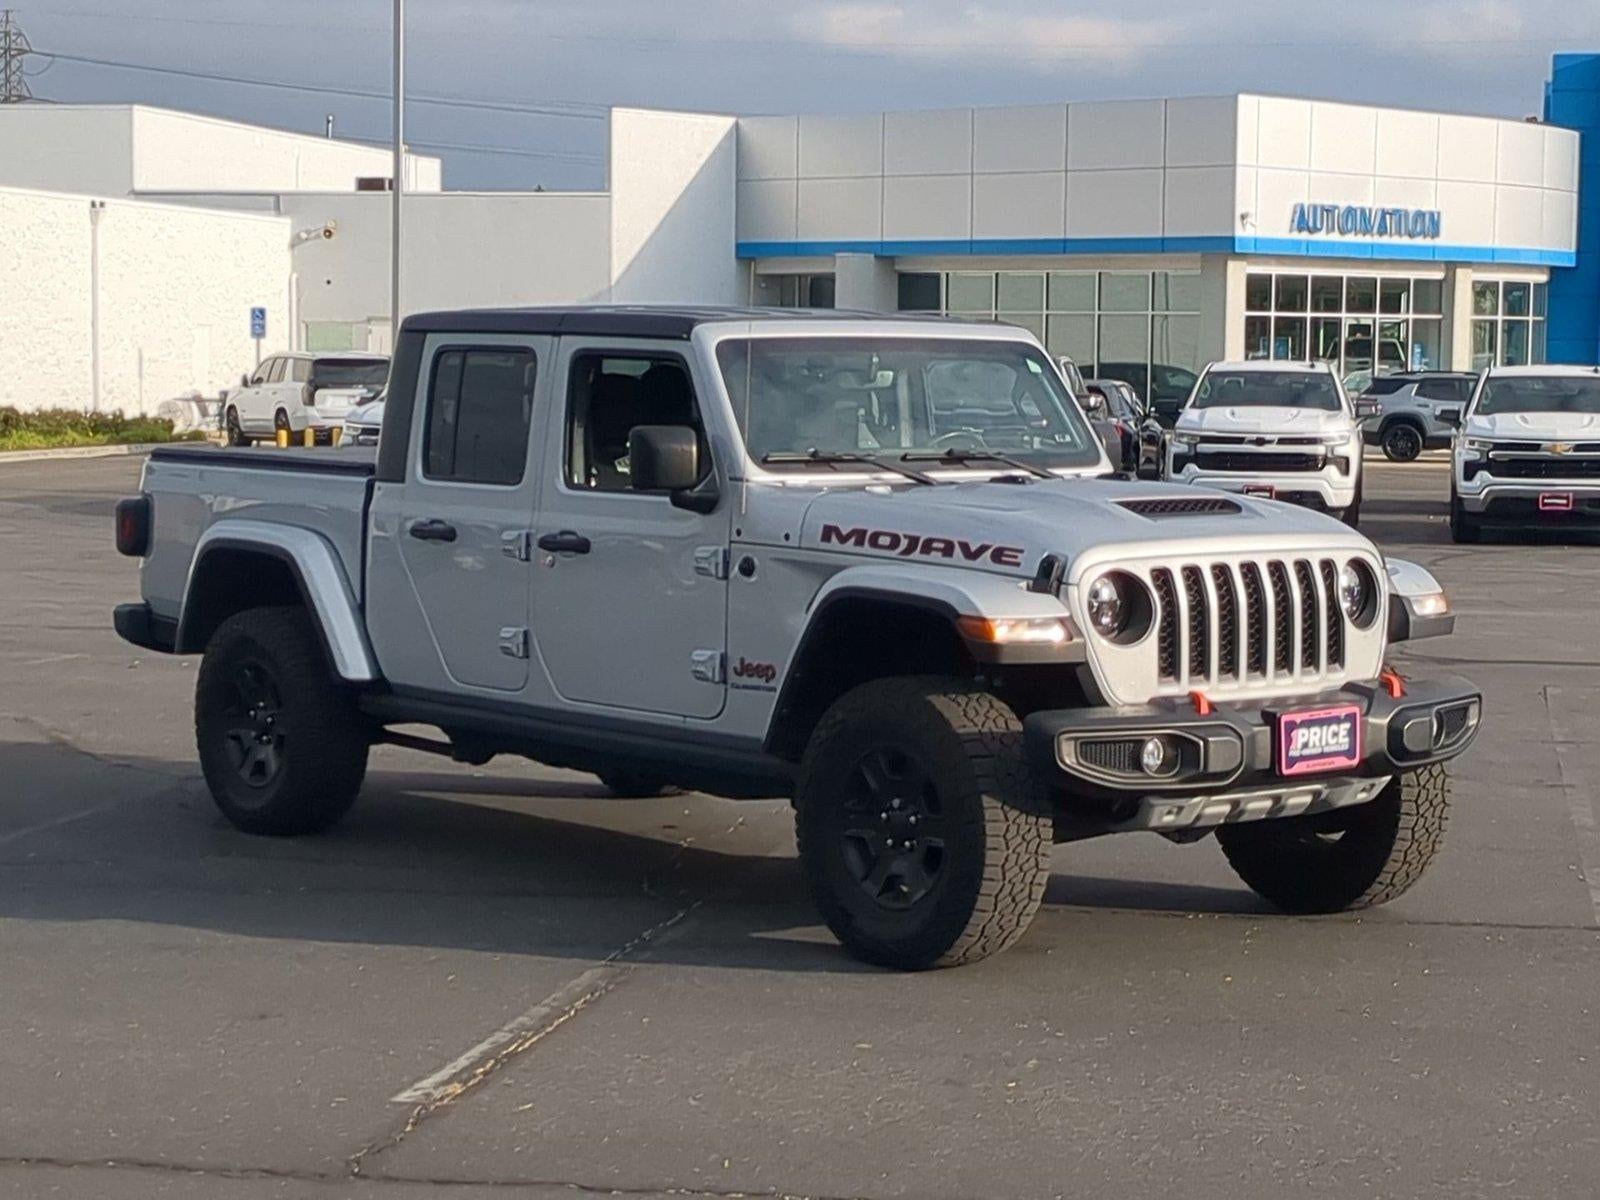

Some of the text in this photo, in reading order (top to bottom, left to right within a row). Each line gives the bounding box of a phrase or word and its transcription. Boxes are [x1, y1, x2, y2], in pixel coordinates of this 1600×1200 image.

[1290, 203, 1441, 239] AUTONATION
[820, 524, 1025, 568] MOJAVE
[733, 656, 777, 684] Jeep
